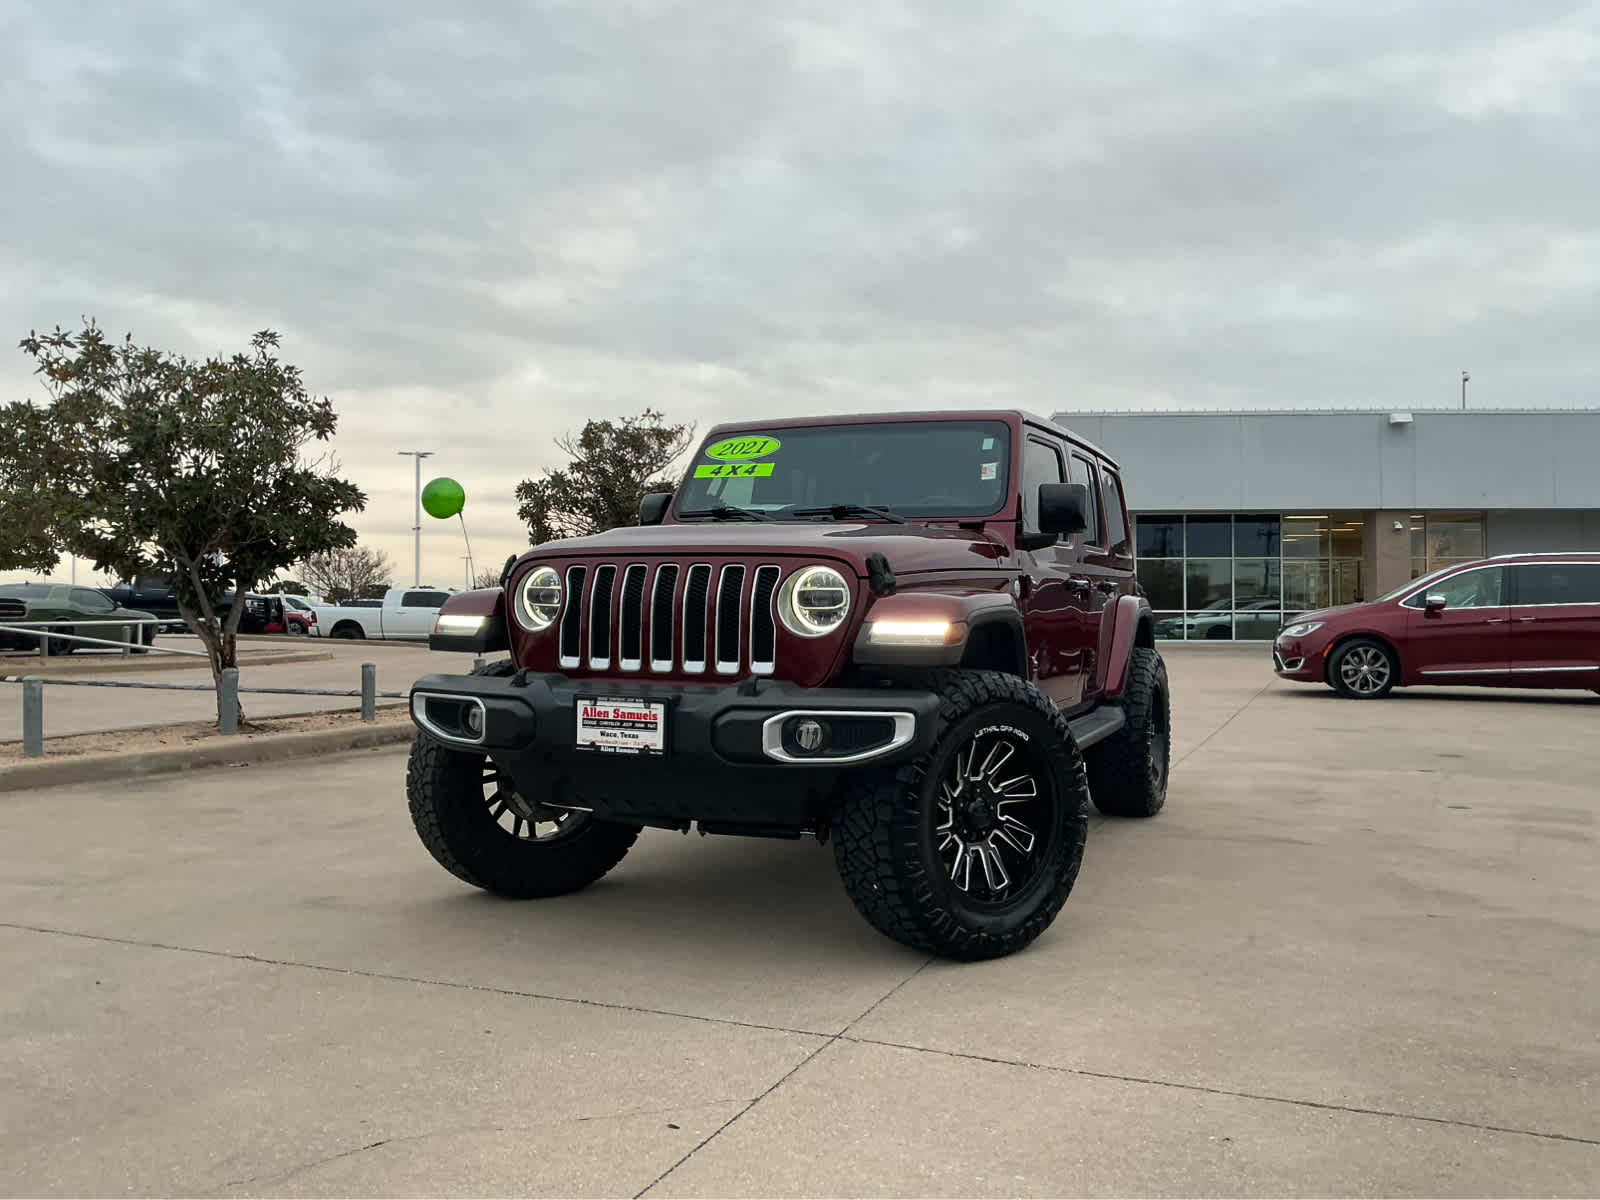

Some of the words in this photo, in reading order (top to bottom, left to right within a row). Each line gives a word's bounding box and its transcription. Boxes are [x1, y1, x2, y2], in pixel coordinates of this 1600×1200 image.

[717, 440, 769, 456] 2021
[582, 706, 610, 718] Allen
[613, 708, 658, 720] Samuels
[620, 731, 639, 739] Texas
[600, 745, 615, 753] Allen
